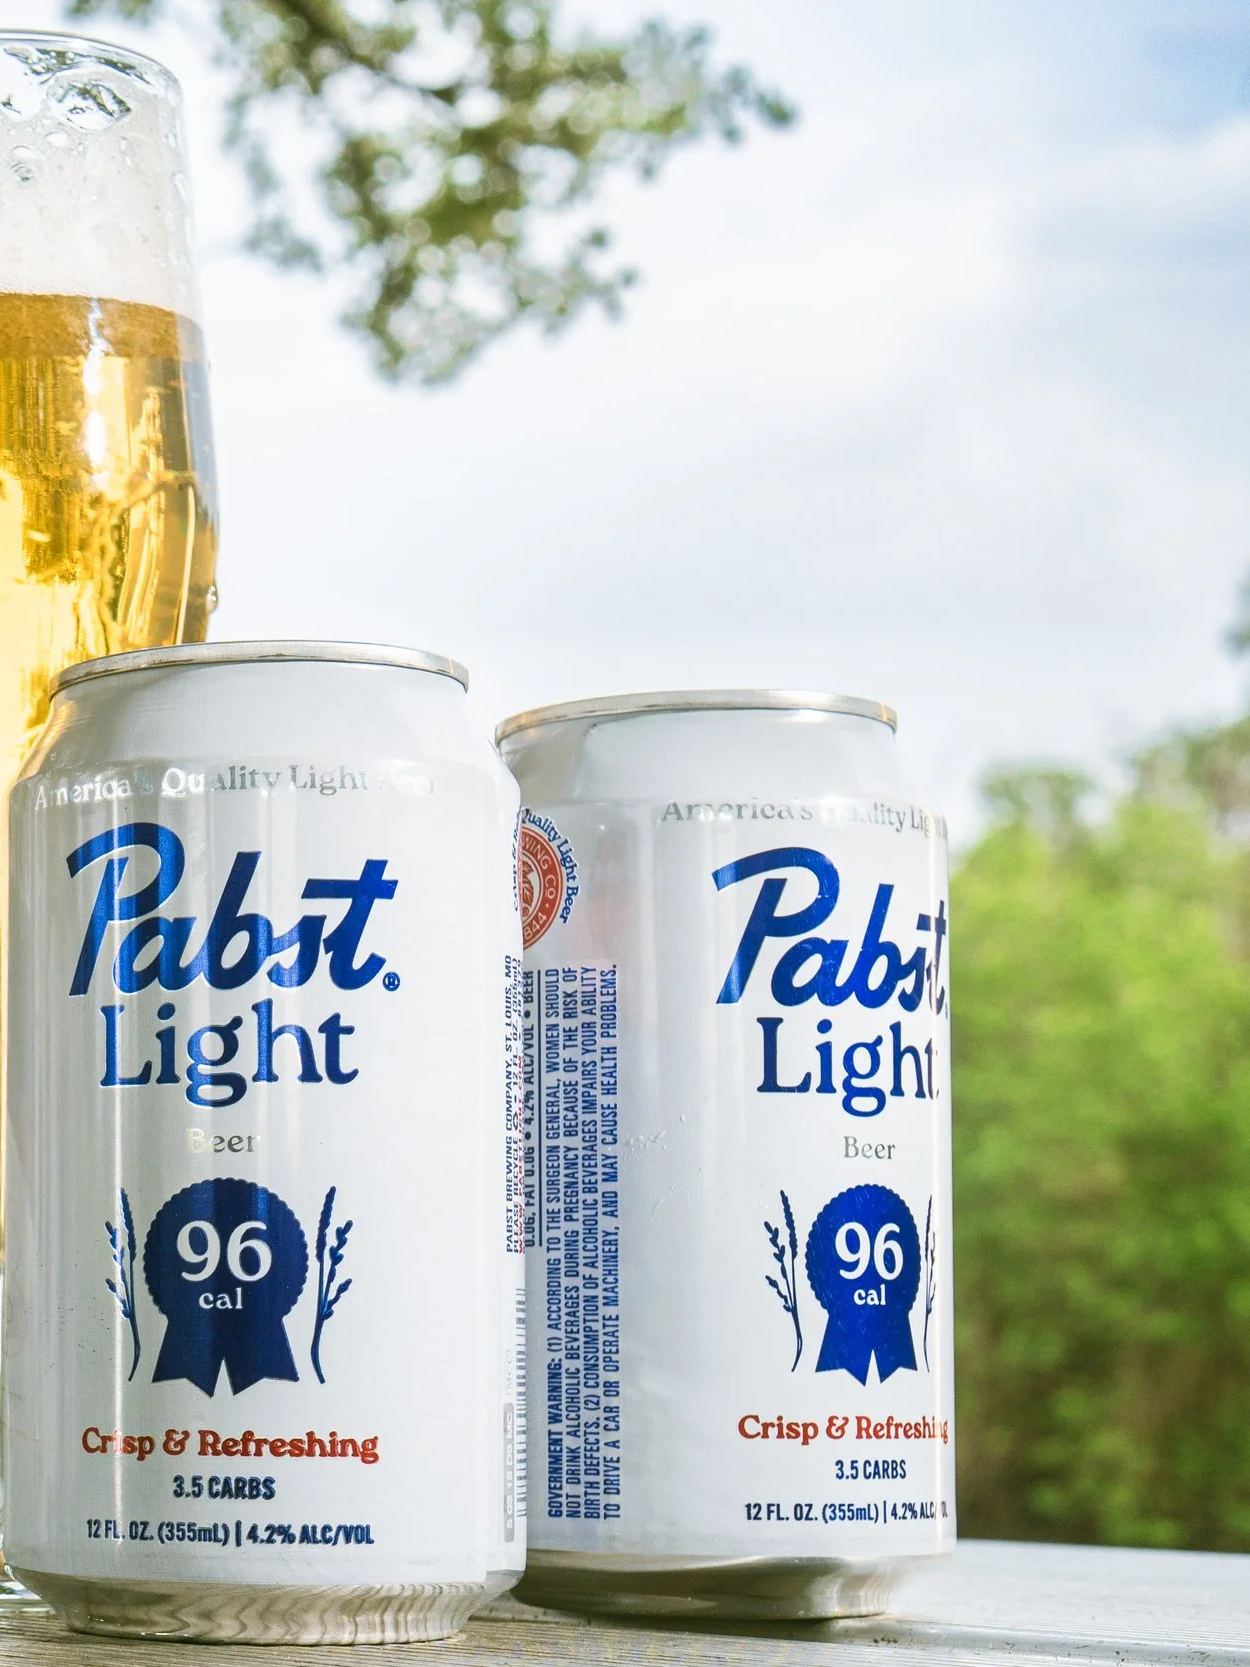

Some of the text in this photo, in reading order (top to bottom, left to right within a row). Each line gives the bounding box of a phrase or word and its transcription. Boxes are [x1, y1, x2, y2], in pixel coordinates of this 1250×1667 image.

[288, 764, 368, 796] Light
[522, 836, 551, 869] WING
[557, 838, 578, 882] Light
[560, 886, 579, 924] Beer
[523, 912, 547, 940] 844
[505, 955, 512, 978] MO
[523, 970, 534, 1004] BEER
[98, 997, 360, 1108] Light
[756, 1016, 939, 1118] Light
[186, 1128, 257, 1153] Beer
[844, 1136, 896, 1160] Beer
[176, 1220, 272, 1282] 96
[545, 968, 563, 1518] GOVERNMENT WARNING: (1) ACCORDING TO THE SURGEON GENERAL, WOMEN SHOULD
[562, 967, 581, 1519] NOT DRINK ALCOHOLIC BEVERAGES DURING PREGNANCY BECAUSE OF THE RISK OF
[581, 966, 600, 1519] BIRTH DEFECTS. (2) CONSUMPTION OF ALCOHOLIC BEVERAGES IMPAIRS YOUR ABILITY
[600, 964, 620, 1520] TO DRIVE A CAR OR OPERATE MACHINERY, AND MAY CAUSE HEALTH PROBLEMS.
[835, 1222, 904, 1281] 96
[198, 1287, 243, 1310] cal
[853, 1283, 886, 1306] cal
[82, 1427, 381, 1465] Crisp & Refreshing
[738, 1414, 819, 1446] Crisp
[826, 1415, 850, 1441] &
[835, 1459, 907, 1480] 3.5 CARBS
[173, 1475, 277, 1500] 3.5 CARBS
[744, 1502, 762, 1521] 12
[766, 1503, 791, 1522] FL.
[794, 1503, 818, 1522] OZ.
[822, 1502, 880, 1524] (355mL)
[891, 1502, 918, 1521] 4.2%
[919, 1501, 948, 1521] ALC/OL
[86, 1518, 102, 1540] 12
[104, 1519, 125, 1541] FL.
[129, 1520, 154, 1542] OZ.
[158, 1521, 230, 1546] (355mL)
[246, 1524, 296, 1544] 4.2%
[300, 1524, 375, 1547] ALC/VOL
